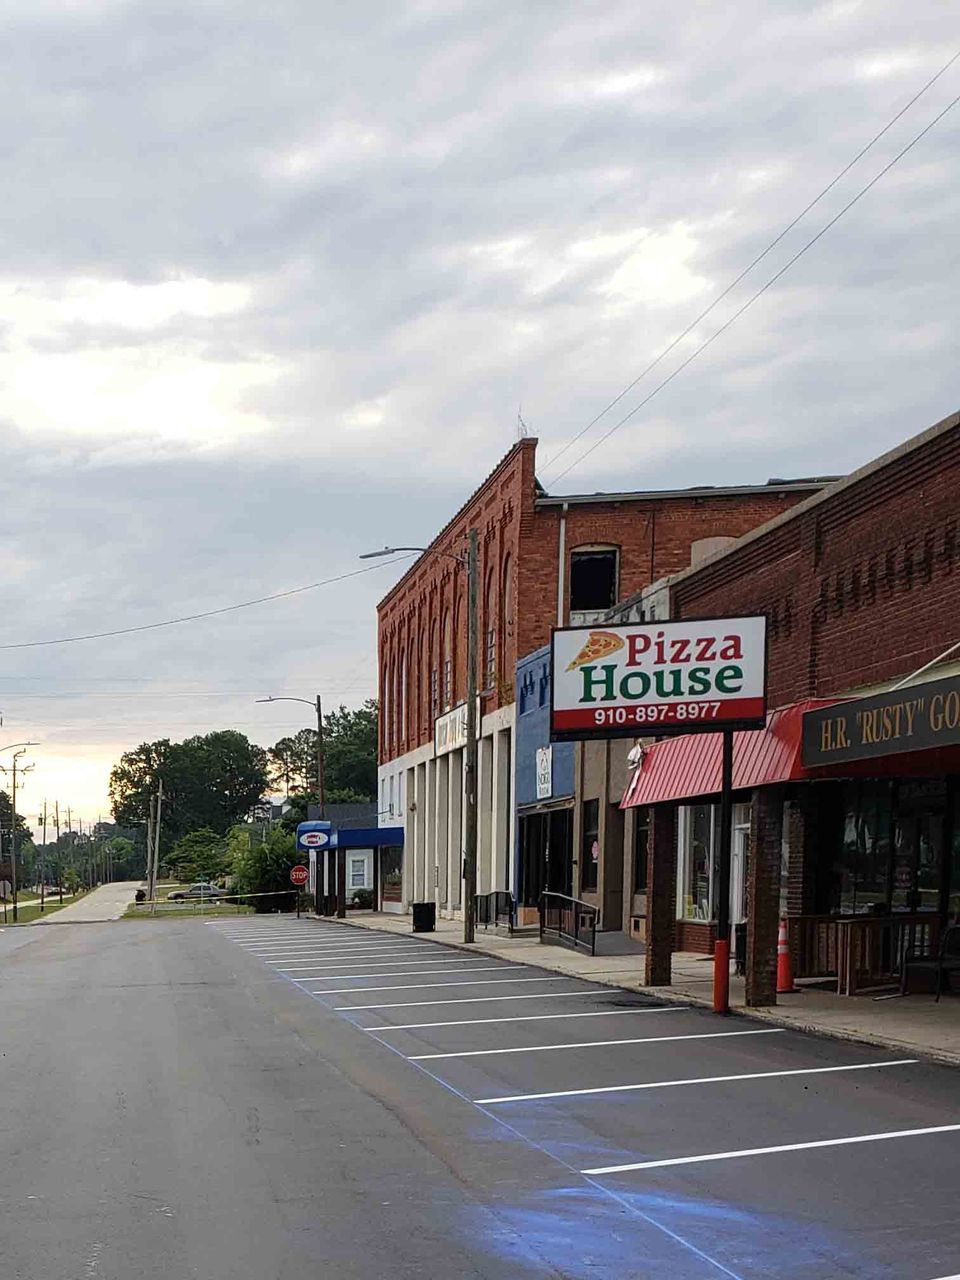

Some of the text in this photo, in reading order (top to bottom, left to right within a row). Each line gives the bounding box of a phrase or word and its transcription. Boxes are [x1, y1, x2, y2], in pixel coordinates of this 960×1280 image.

[625, 631, 744, 667] Pizza
[578, 664, 744, 703] House
[594, 702, 721, 725] 910-897-8977
[820, 717, 852, 752] H.R.
[929, 690, 960, 732] GO
[292, 871, 307, 880] STOP
